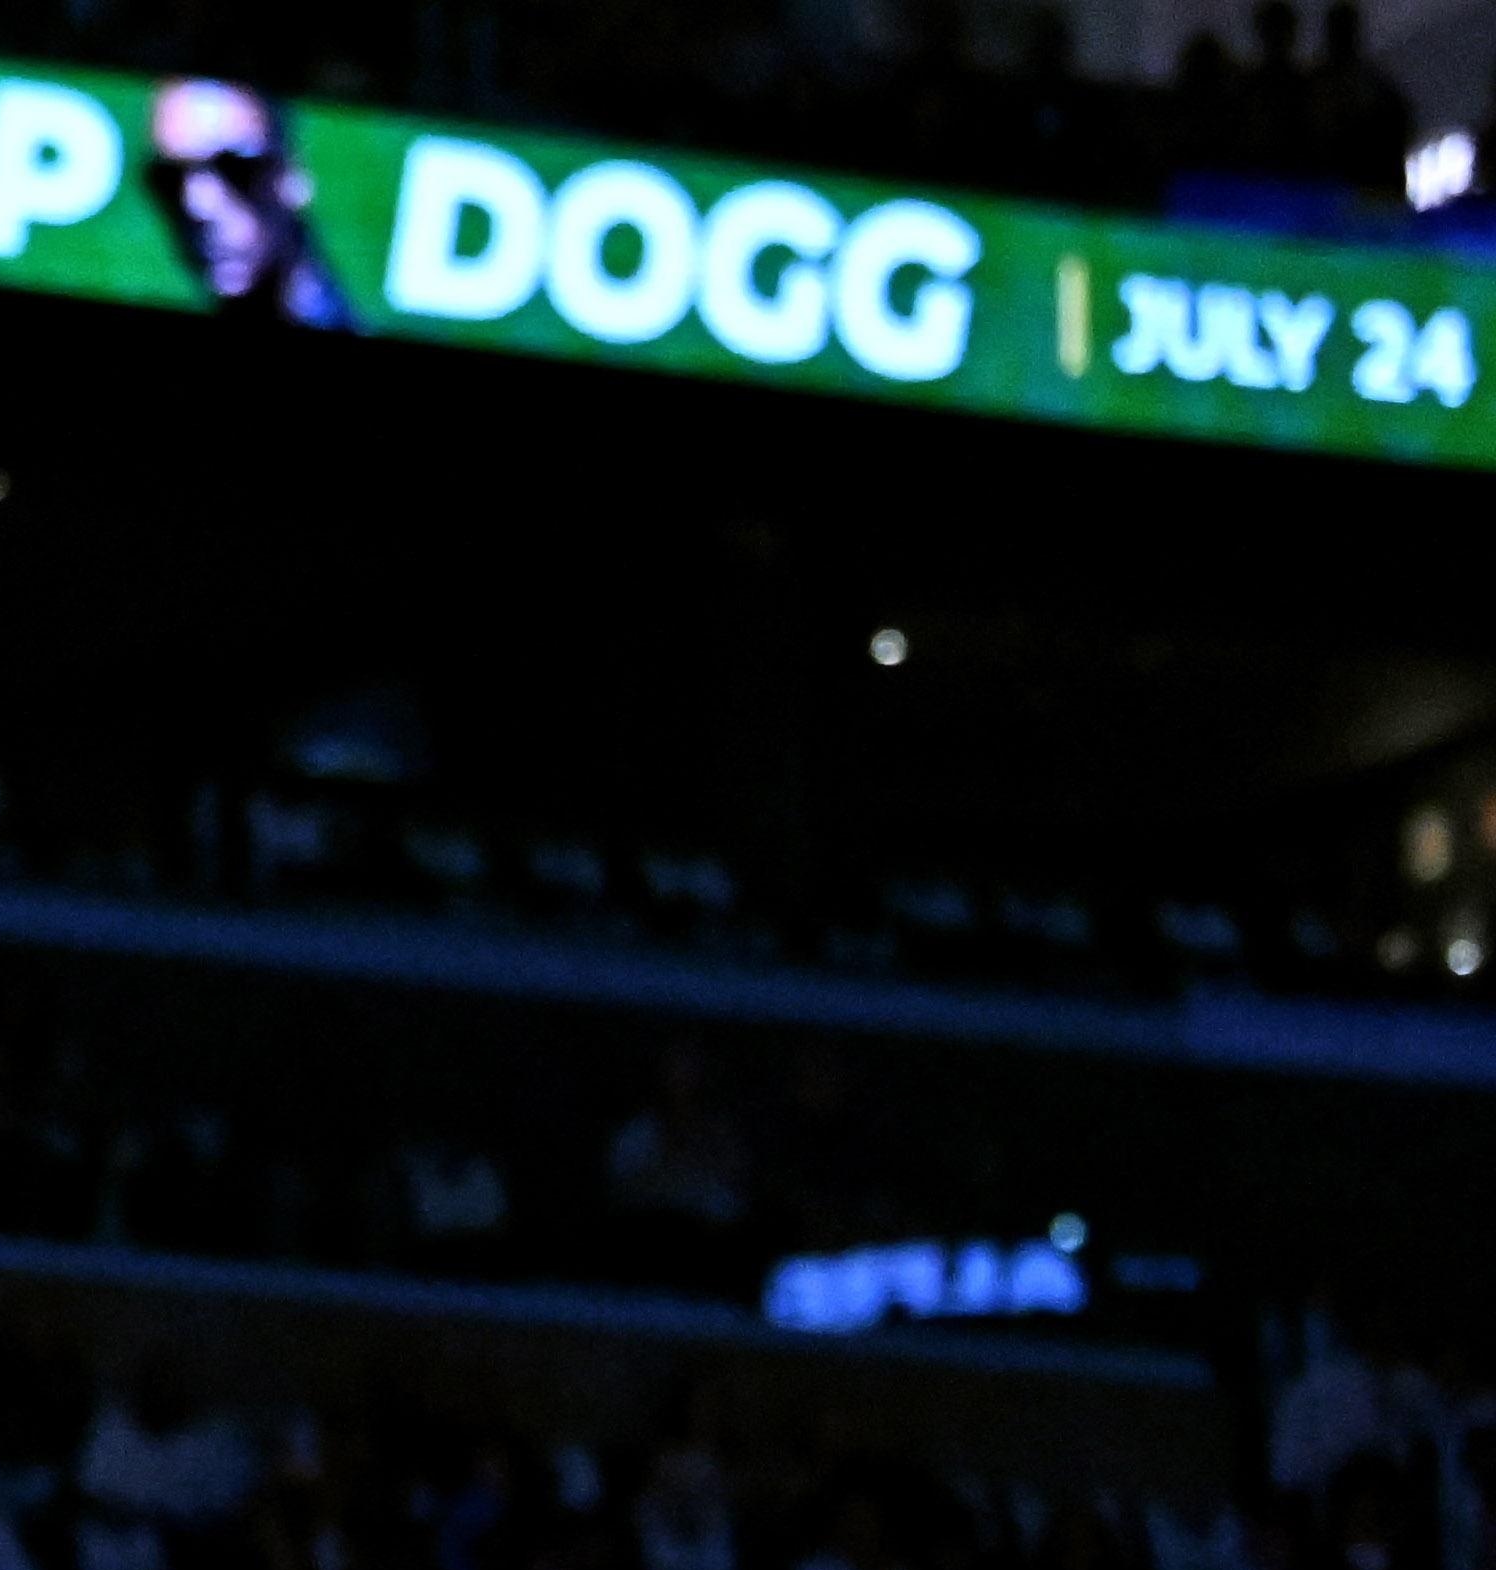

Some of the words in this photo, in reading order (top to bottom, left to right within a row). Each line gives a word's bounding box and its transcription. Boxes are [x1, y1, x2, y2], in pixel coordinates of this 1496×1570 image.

[383, 134, 981, 382] DOGG
[1112, 273, 1336, 392] JULY
[1351, 299, 1476, 407] 24
